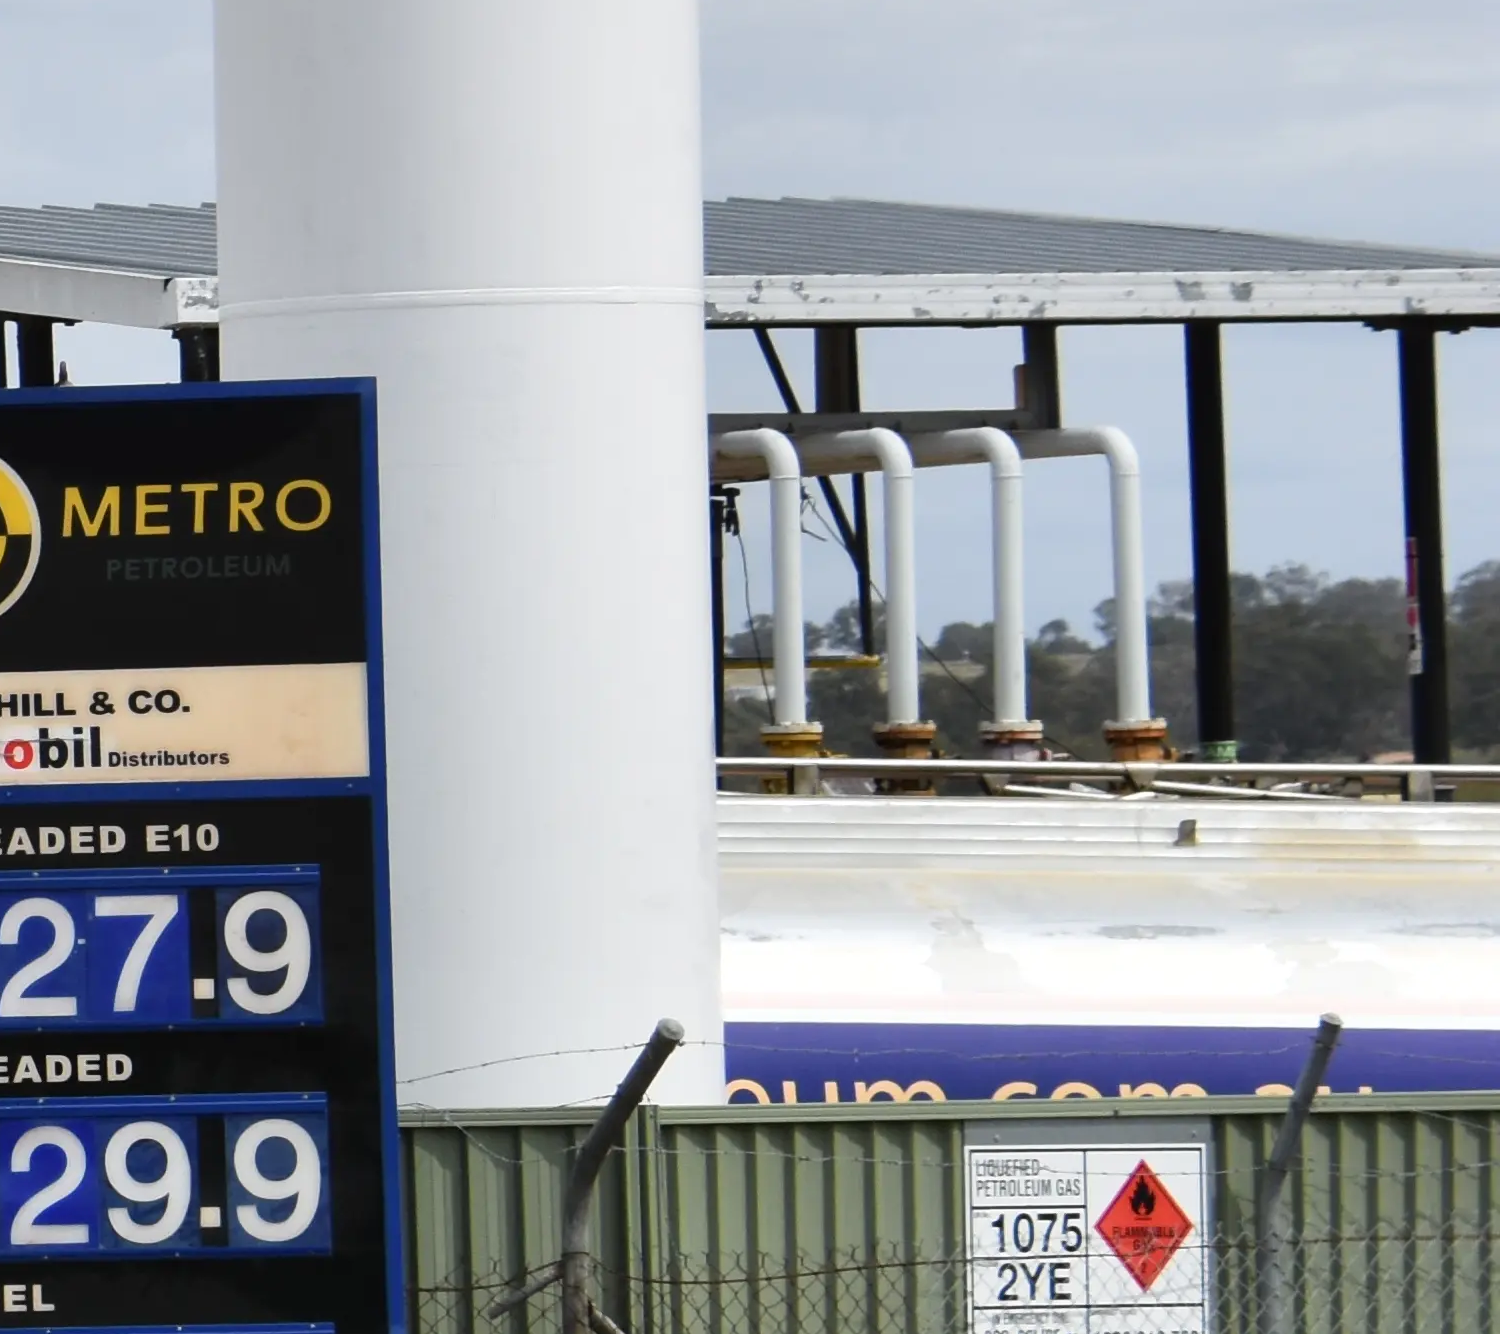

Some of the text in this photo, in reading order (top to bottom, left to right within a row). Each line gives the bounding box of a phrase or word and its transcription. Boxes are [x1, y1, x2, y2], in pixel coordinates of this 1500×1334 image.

[62, 480, 331, 537] METRO
[106, 554, 291, 581] PETROLEUM
[89, 690, 115, 715] &
[128, 689, 191, 715] CO.
[108, 749, 230, 768] Distributors
[146, 823, 220, 852] E10
[976, 1159, 1040, 1177] LIQUEFIED
[976, 1178, 1081, 1197] PETROLEUM GAS
[991, 1213, 1082, 1253] 1075
[997, 1263, 1072, 1301] 2YE
